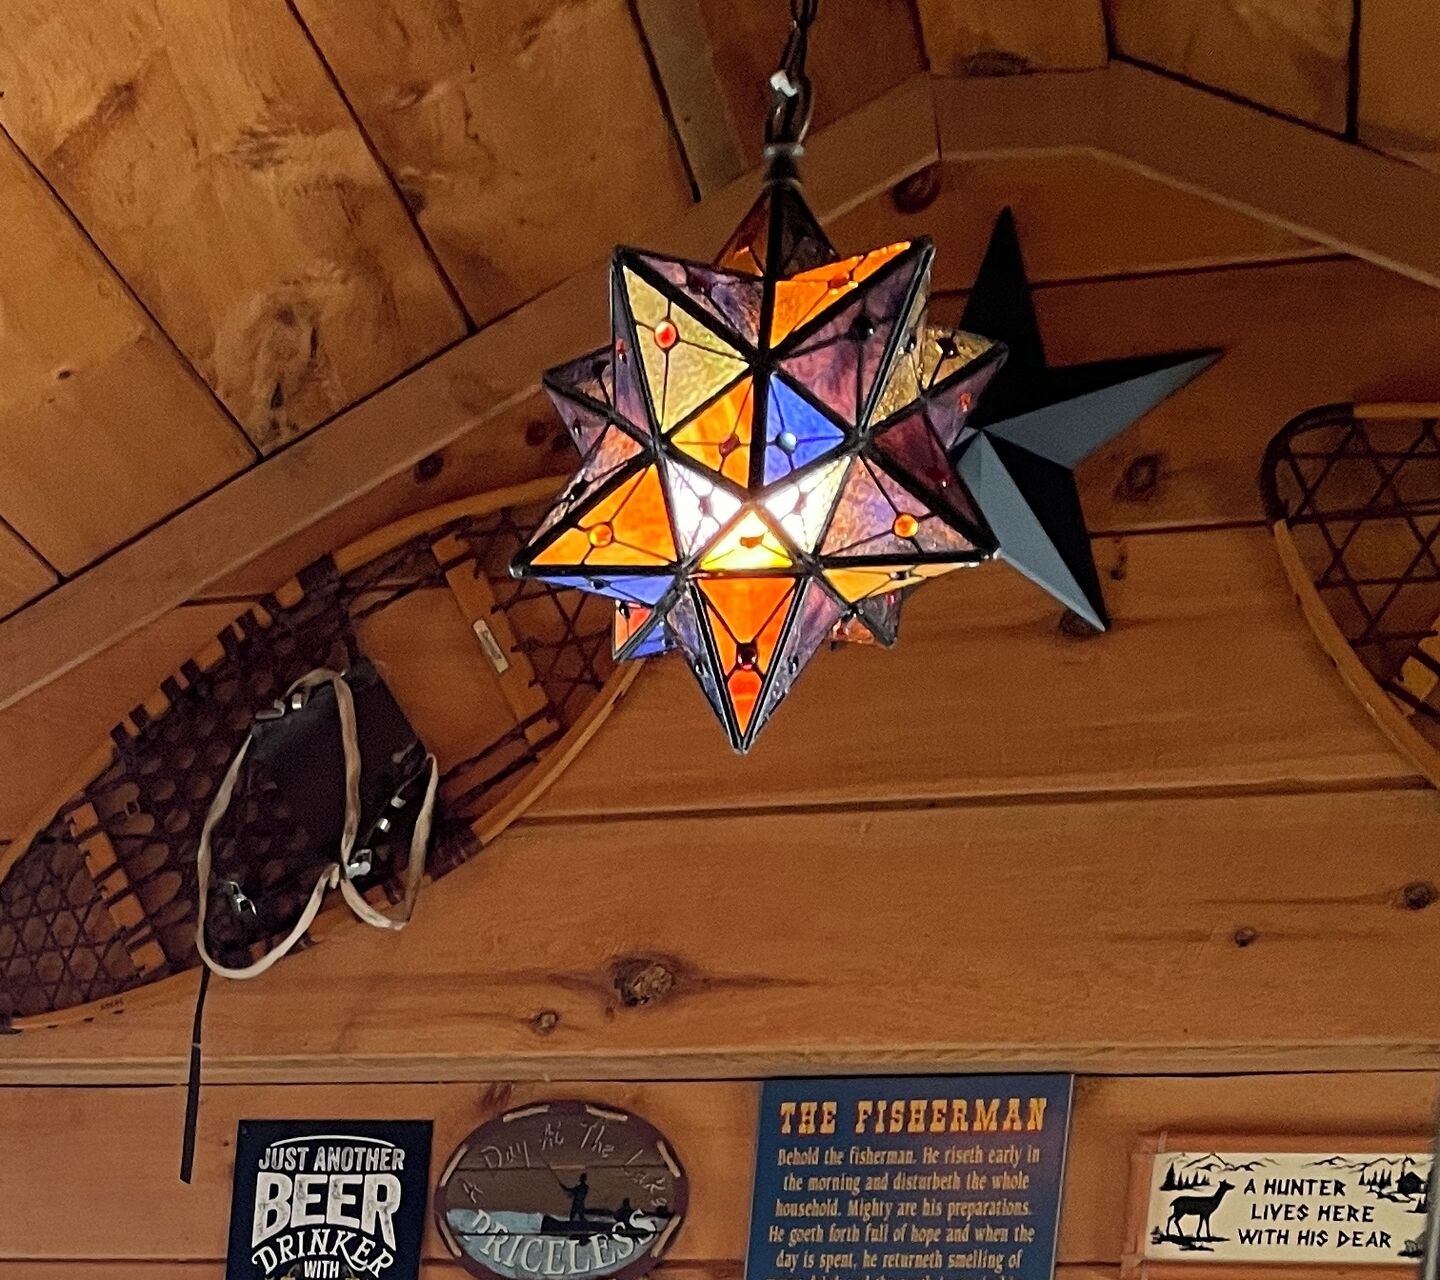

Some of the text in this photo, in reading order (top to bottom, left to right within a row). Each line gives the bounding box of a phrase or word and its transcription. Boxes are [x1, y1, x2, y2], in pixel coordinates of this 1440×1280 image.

[780, 1098, 1047, 1134] THE FISHERMAN
[258, 1147, 405, 1171] JUST ANOTHER
[777, 1145, 1040, 1168] Behold the fisherman. He riseth early in
[783, 1171, 1029, 1196] the morning and disturbeth the whole
[1244, 1179, 1346, 1197] A HUNTER
[252, 1172, 401, 1251] BEER
[775, 1198, 1031, 1221] household. Mighty are his preparations.
[1251, 1203, 1375, 1223] LIVES HERE
[463, 1209, 657, 1275] PRICELESS
[768, 1223, 1035, 1247] He goeth forth full of hope and when the
[1238, 1228, 1392, 1248] WITH HIS DEAR
[252, 1229, 394, 1278] DRINKER
[776, 1250, 799, 1273] day
[803, 1251, 814, 1268] is
[862, 1250, 877, 1268] he
[883, 1250, 942, 1268] returneth
[948, 1250, 1004, 1274] smelling
[1008, 1250, 1023, 1268] of
[304, 1260, 339, 1278] WITH
